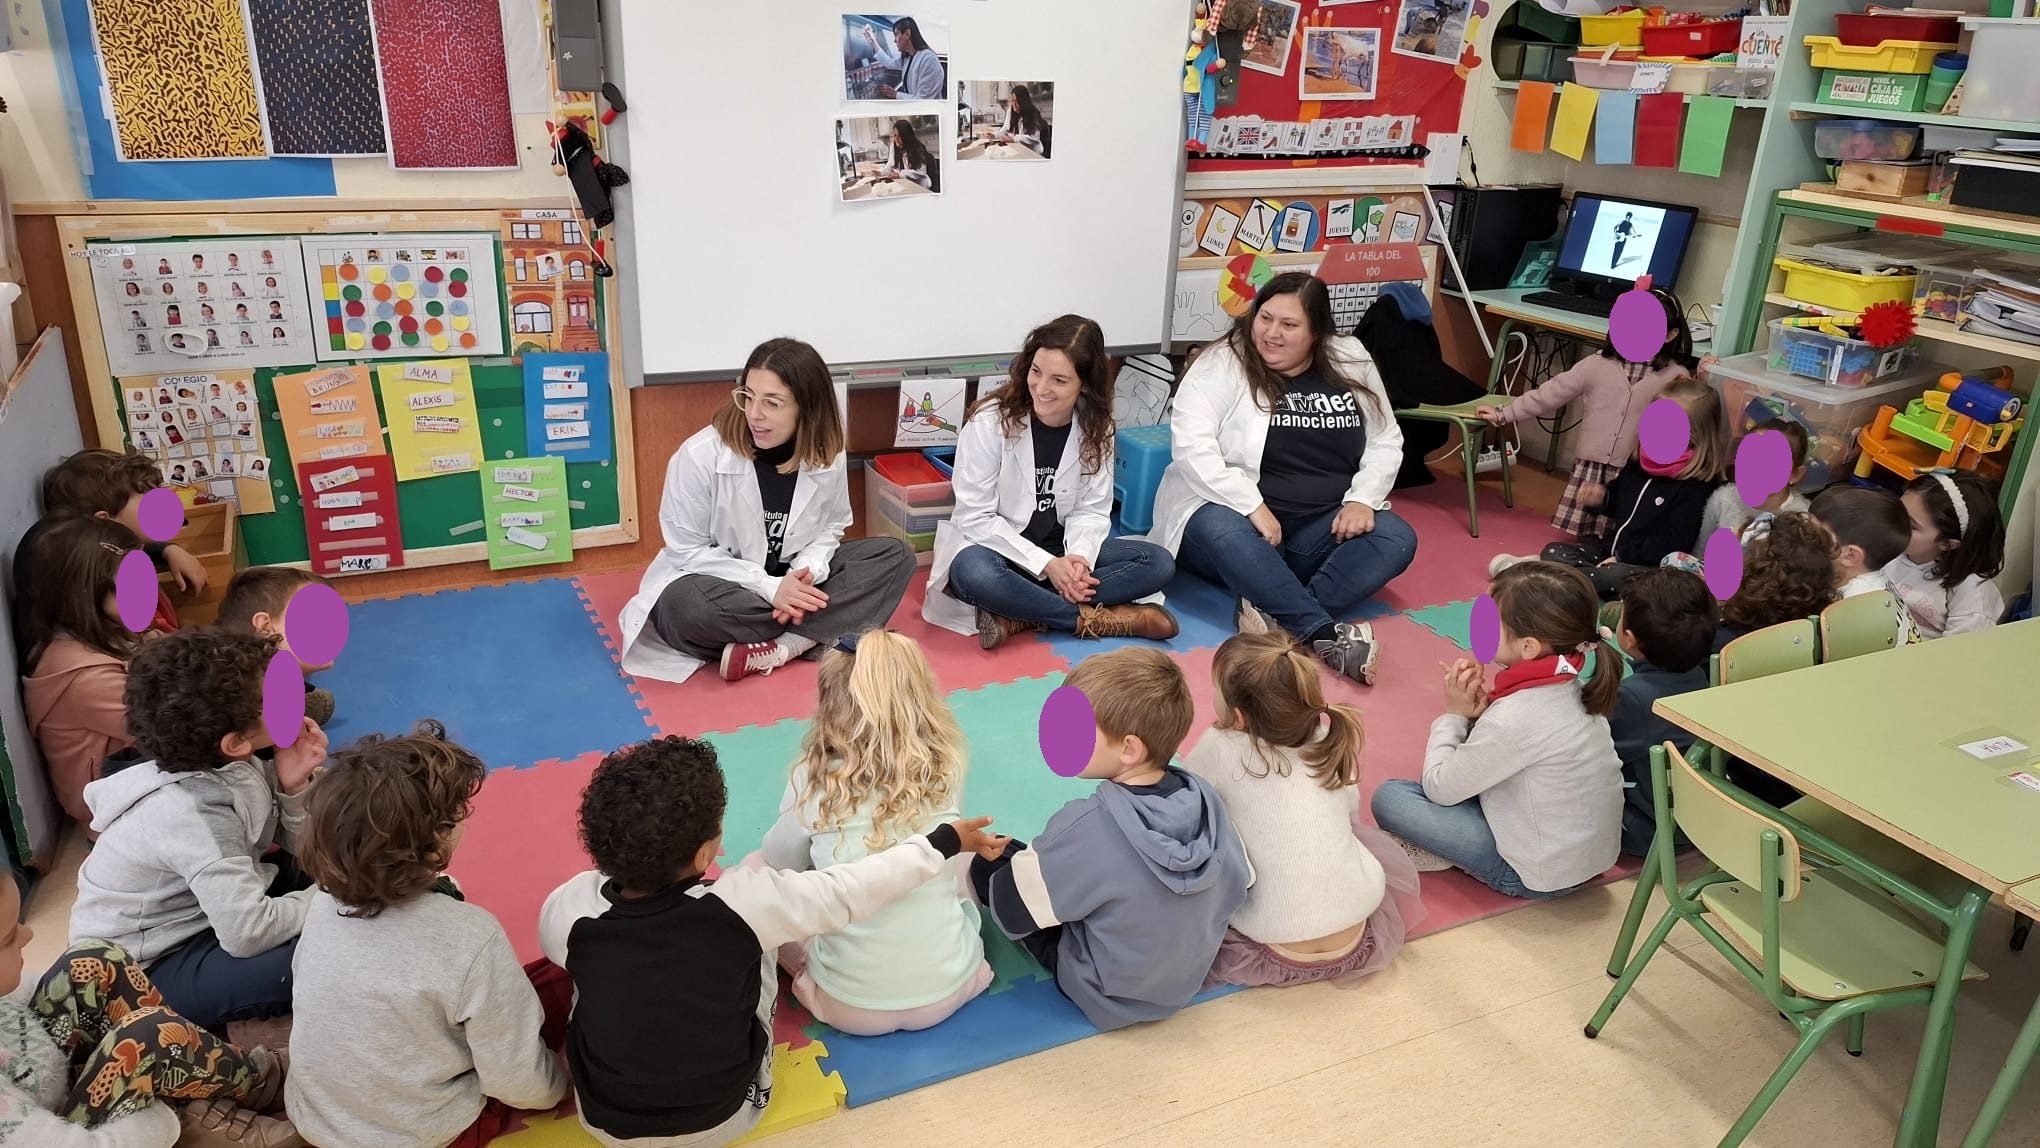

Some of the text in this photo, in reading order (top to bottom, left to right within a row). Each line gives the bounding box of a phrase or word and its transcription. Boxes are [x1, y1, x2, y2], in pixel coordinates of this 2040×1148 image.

[1871, 84, 1905, 96] CAJA DE
[1867, 93, 1901, 106] JUEGOS
[1239, 228, 1263, 245] MARTES
[1329, 227, 1350, 235] JUEVES
[1206, 235, 1225, 250] LUNES
[70, 250, 87, 258] HOY
[1345, 250, 1402, 262] LA TABLA DEL
[1366, 266, 1381, 276] 100
[409, 367, 438, 380] ALMA
[311, 380, 341, 394] BRUNO
[412, 395, 442, 407] ALEXIS
[1271, 412, 1361, 429] nanociencia
[553, 426, 578, 436] ERIK
[505, 487, 535, 498] HECTOR
[341, 557, 380, 570] MARCO
